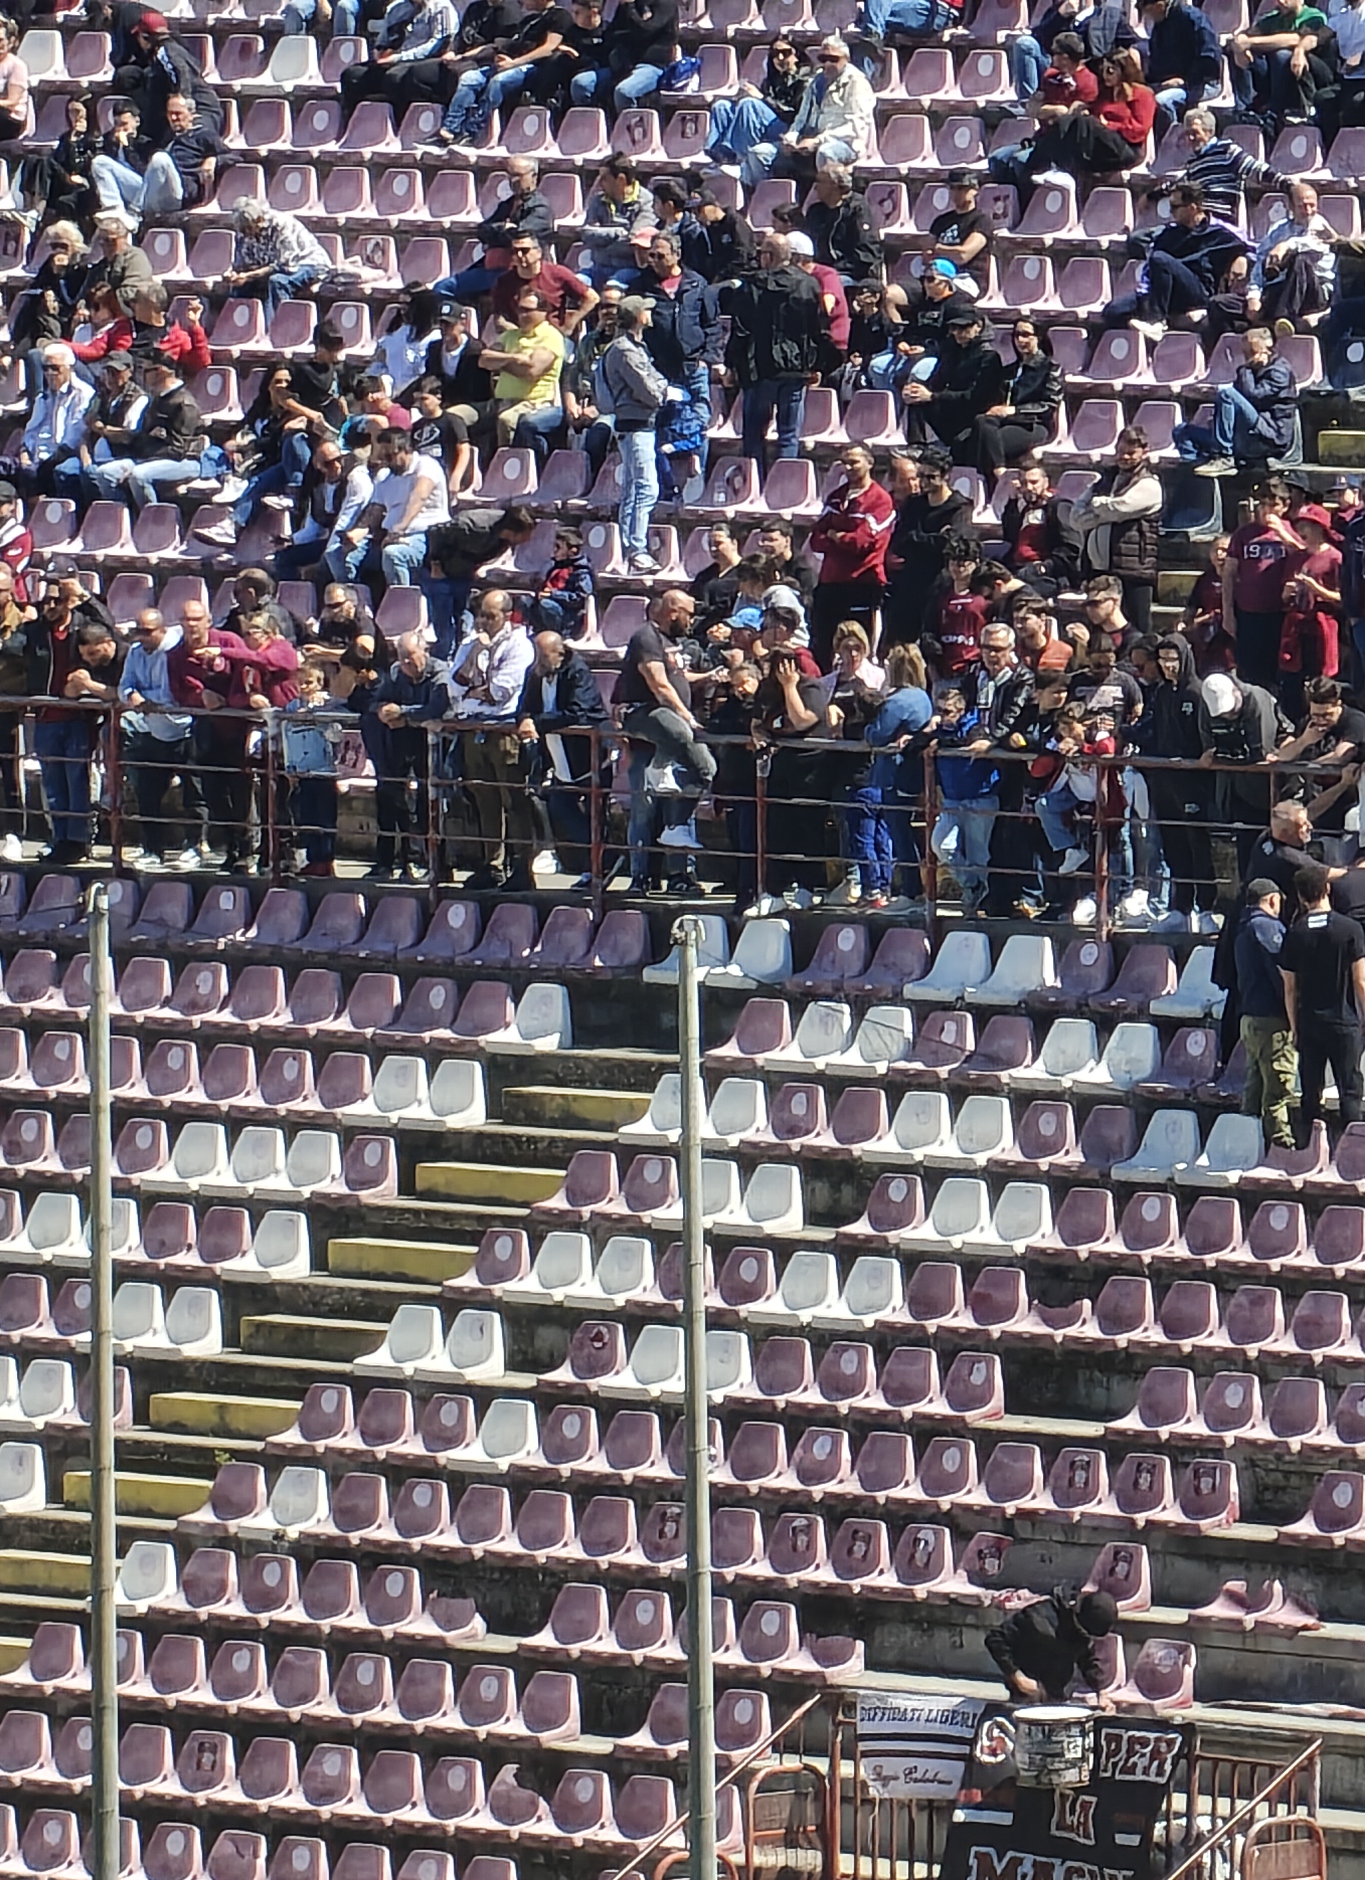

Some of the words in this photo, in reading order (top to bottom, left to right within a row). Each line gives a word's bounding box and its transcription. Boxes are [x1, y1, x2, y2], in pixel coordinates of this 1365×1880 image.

[925, 1708, 979, 1730] LIBERI
[1099, 1727, 1183, 1784] PER
[1051, 1788, 1098, 1846] LA
